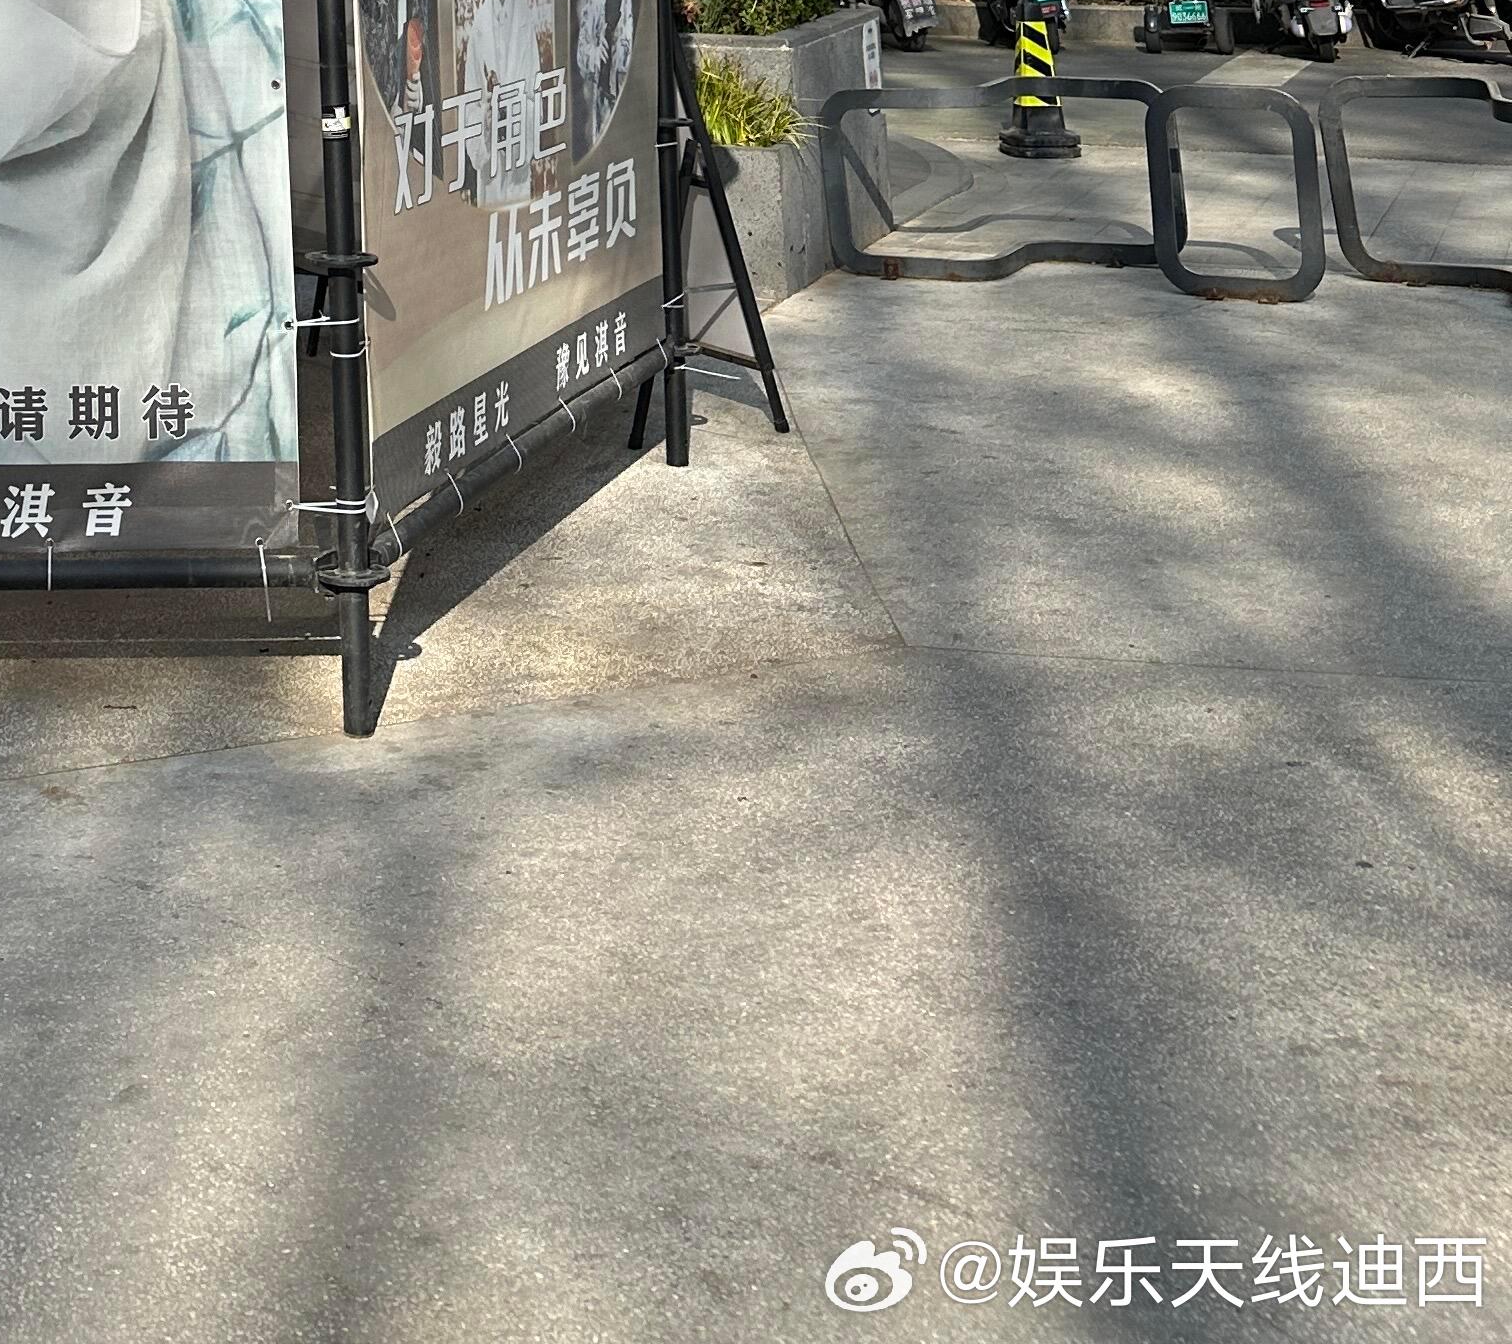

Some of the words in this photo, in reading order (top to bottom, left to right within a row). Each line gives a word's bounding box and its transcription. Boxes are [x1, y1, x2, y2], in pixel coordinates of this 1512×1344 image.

[394, 66, 568, 216] 对于角色
[484, 157, 637, 313] 从未辜负
[555, 311, 628, 392] 豫见淇音
[424, 380, 510, 477] 毅路星光
